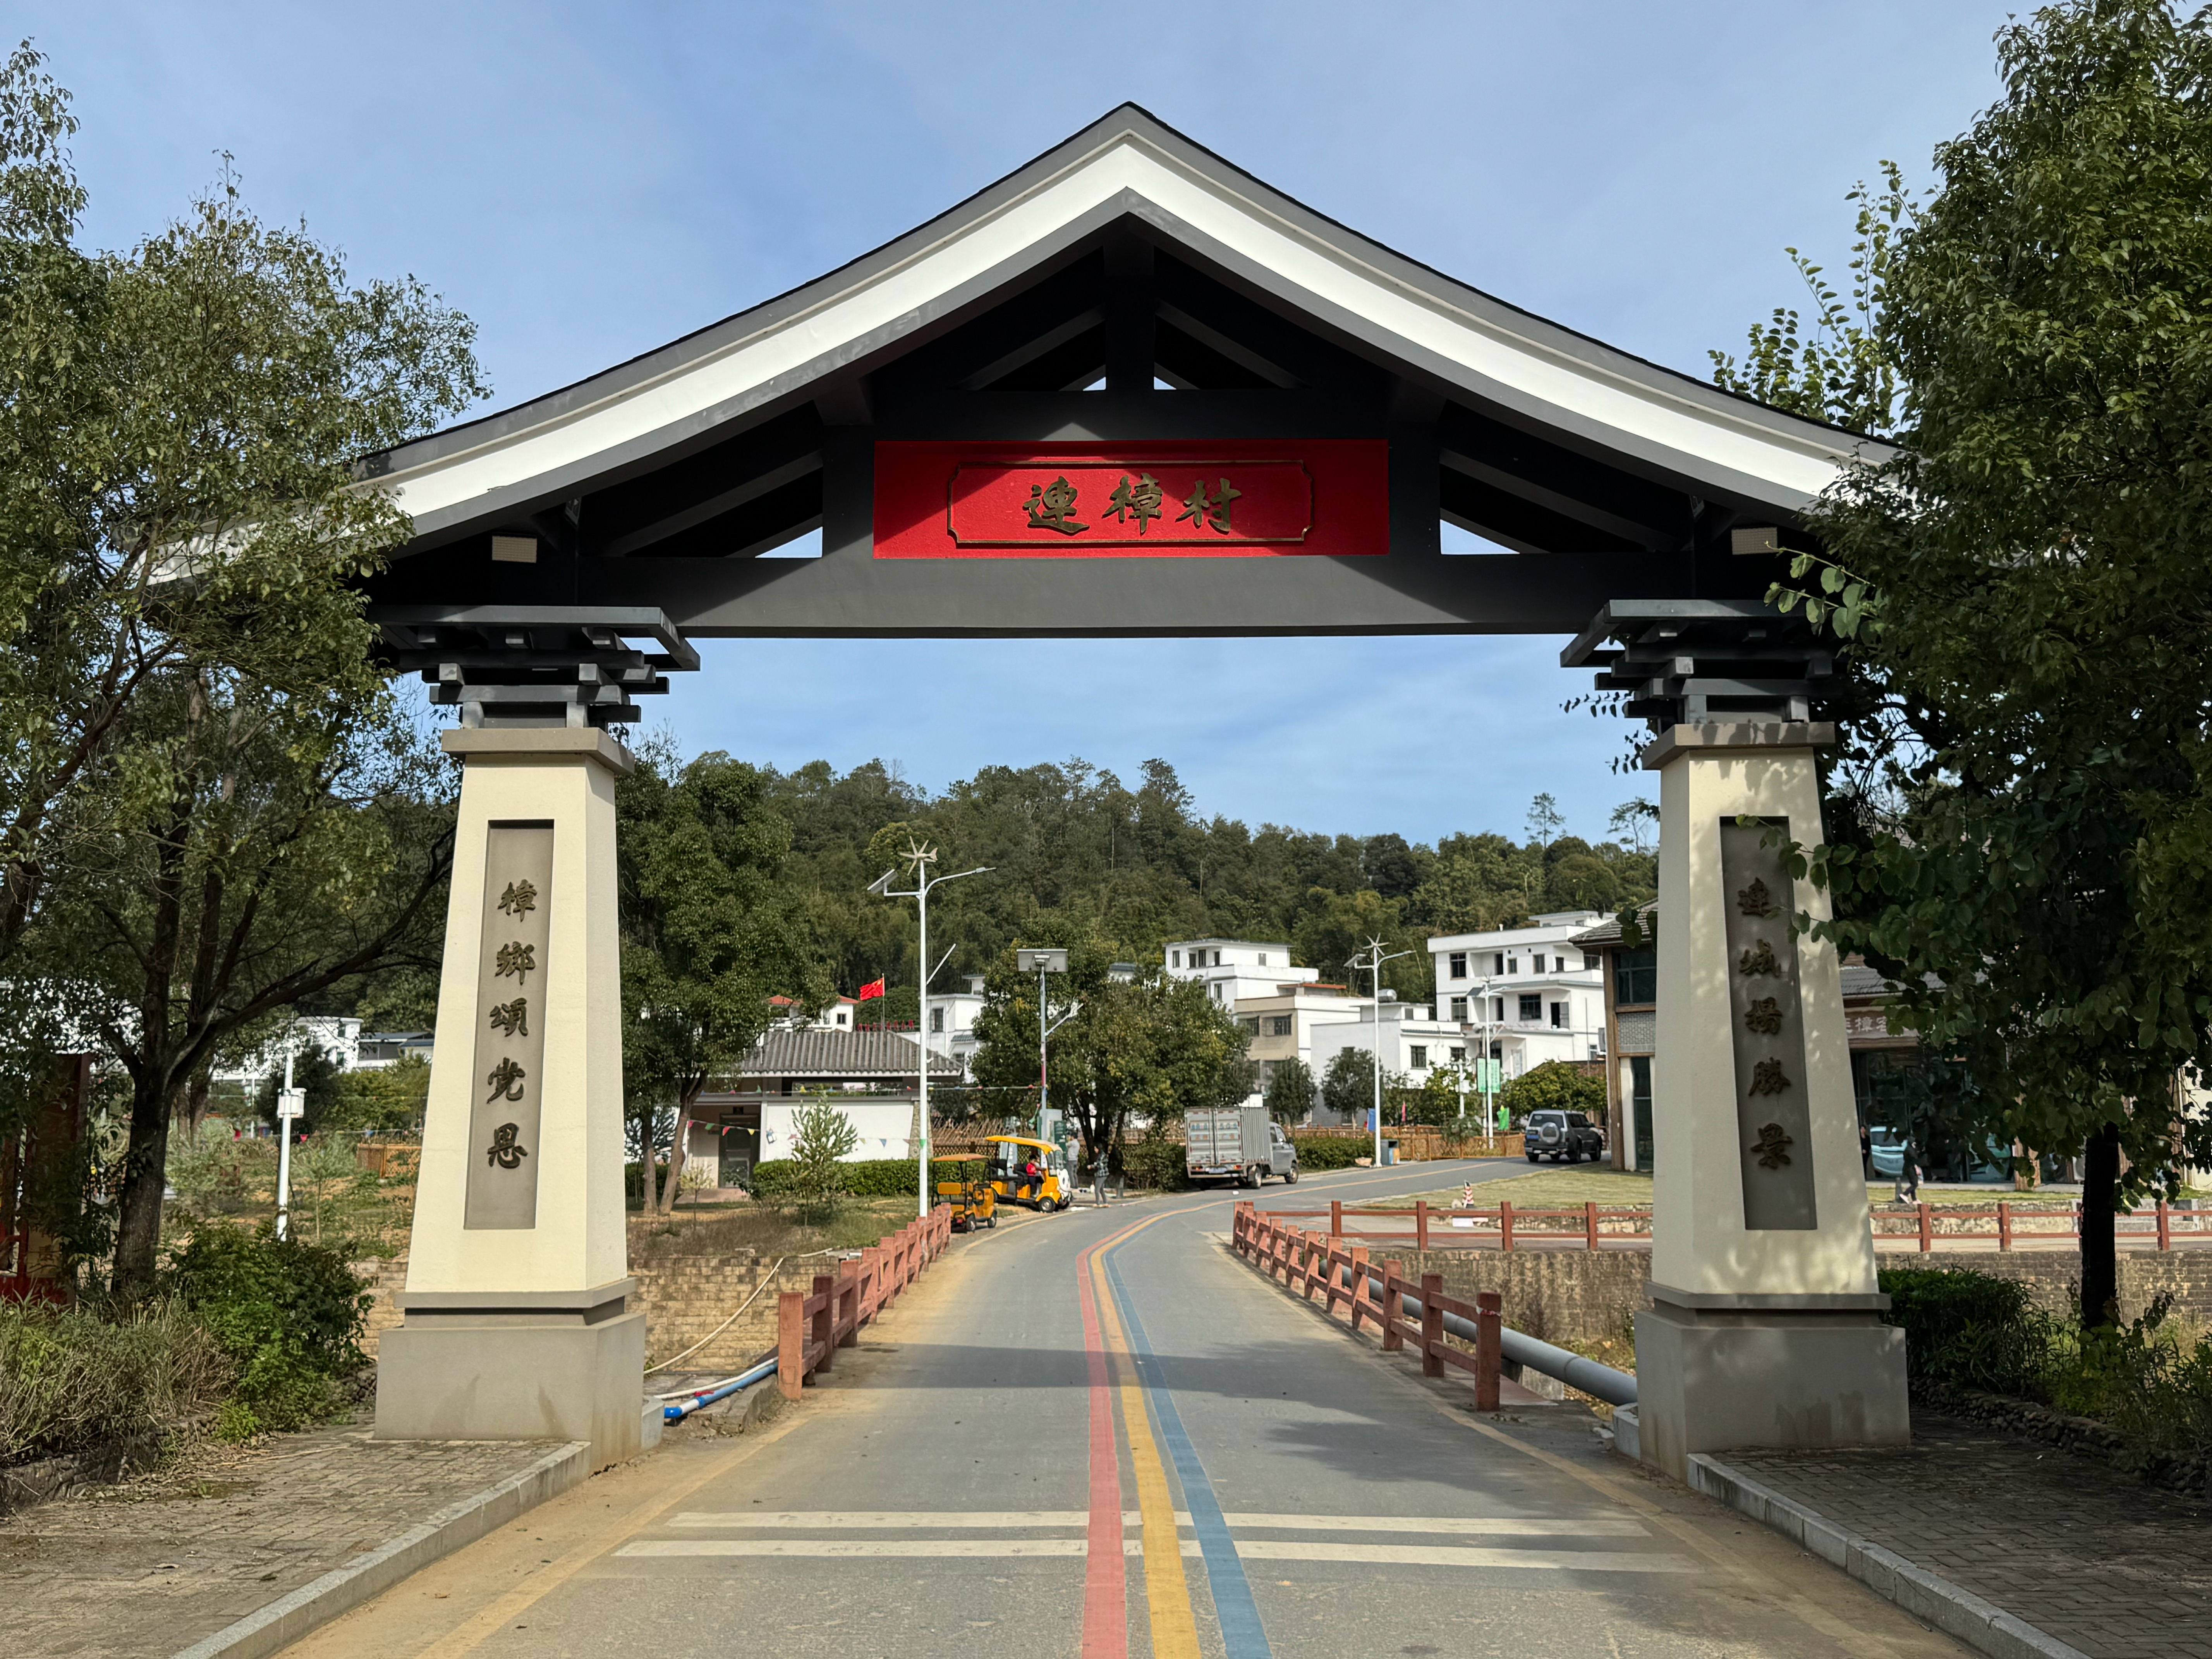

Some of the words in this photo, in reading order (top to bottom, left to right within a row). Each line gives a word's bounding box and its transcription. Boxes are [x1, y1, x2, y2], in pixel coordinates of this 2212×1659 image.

[1022, 473, 1242, 534] 連樟村
[487, 879, 538, 1169] 樟鄉頌党恩
